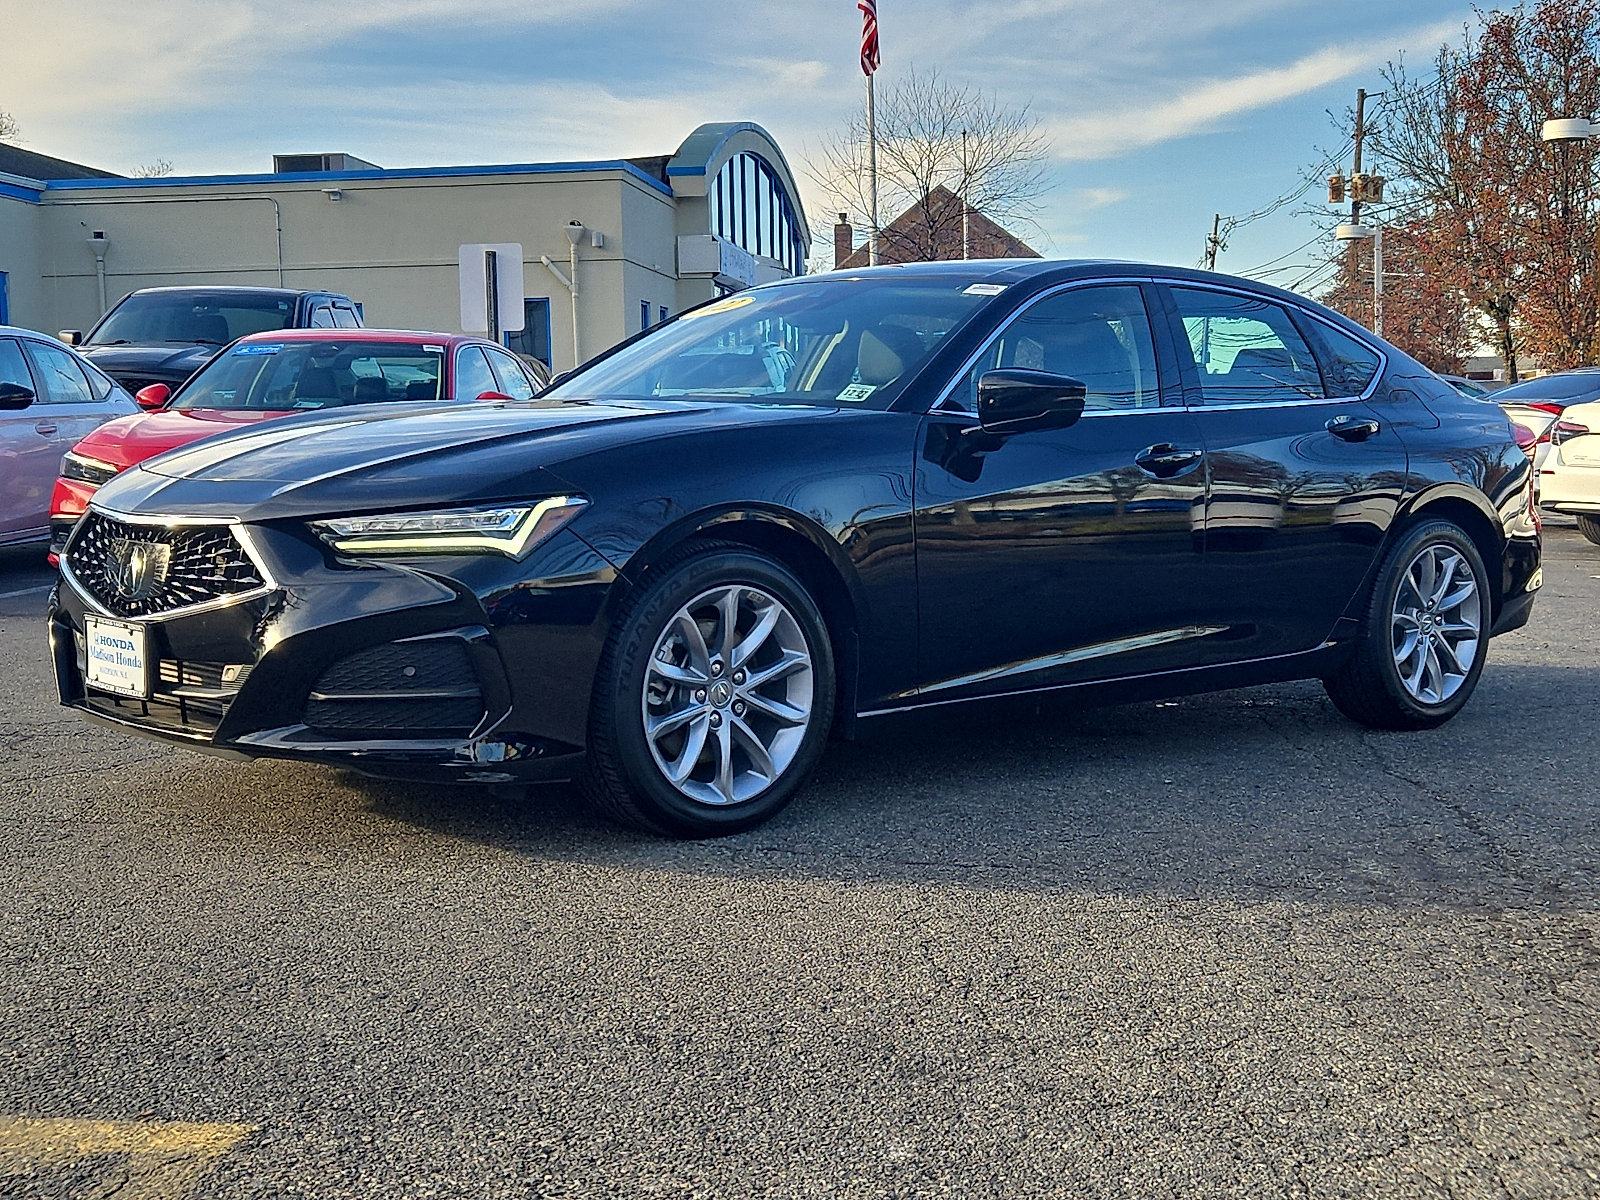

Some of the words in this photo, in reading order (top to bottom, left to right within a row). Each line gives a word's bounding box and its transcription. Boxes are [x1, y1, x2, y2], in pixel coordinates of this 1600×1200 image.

[100, 635, 135, 651] HONDA
[618, 580, 683, 694] TURANZA
[116, 652, 142, 668] Honda
